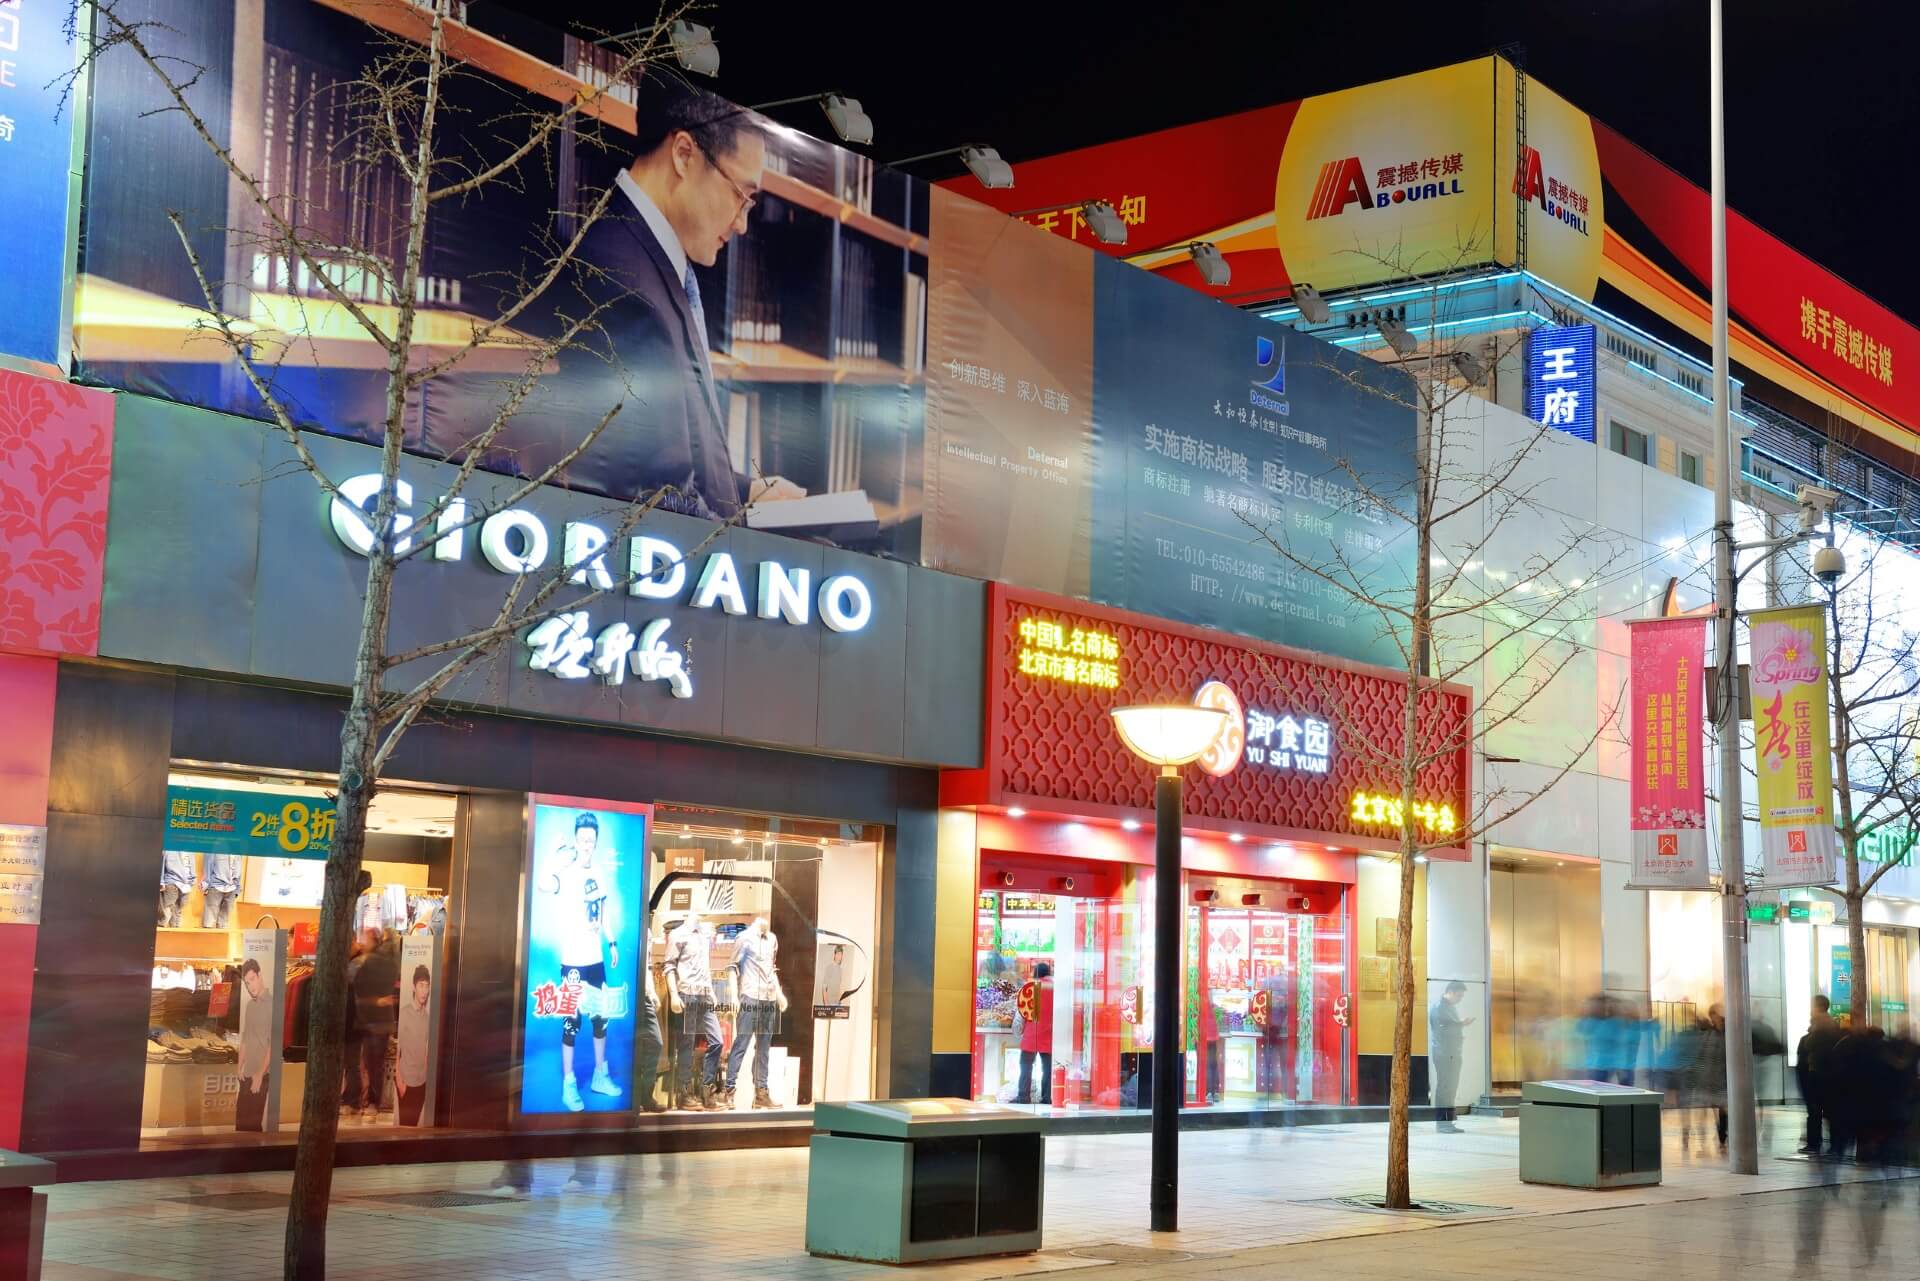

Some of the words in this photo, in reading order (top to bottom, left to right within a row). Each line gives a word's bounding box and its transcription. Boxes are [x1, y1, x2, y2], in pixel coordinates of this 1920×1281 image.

[1376, 153, 1464, 188] 震撼传媒
[1801, 295, 1893, 387] 携手震撼传媒
[951, 359, 1006, 392] 创新思维
[1017, 380, 1070, 414] 深入蓝海
[946, 440, 996, 466] Intellectual
[1001, 456, 1039, 479] Property
[1027, 446, 1068, 469] Deternal
[1144, 423, 1249, 484] 实施商标战略
[1144, 466, 1191, 497] 商标注册
[330, 472, 872, 633] GIORDANO
[1156, 537, 1265, 583] TEL:010-65542486
[1019, 648, 1118, 688] 北京市著名商标
[1755, 654, 1822, 683] Spring
[1247, 710, 1329, 756] 御食园
[1793, 701, 1814, 801] 在这里绽放
[1247, 747, 1264, 763] YU
[1270, 750, 1290, 767] SHI
[1295, 753, 1328, 772] YUAN
[170, 818, 209, 830] Selected
[172, 799, 235, 819] 精选货品
